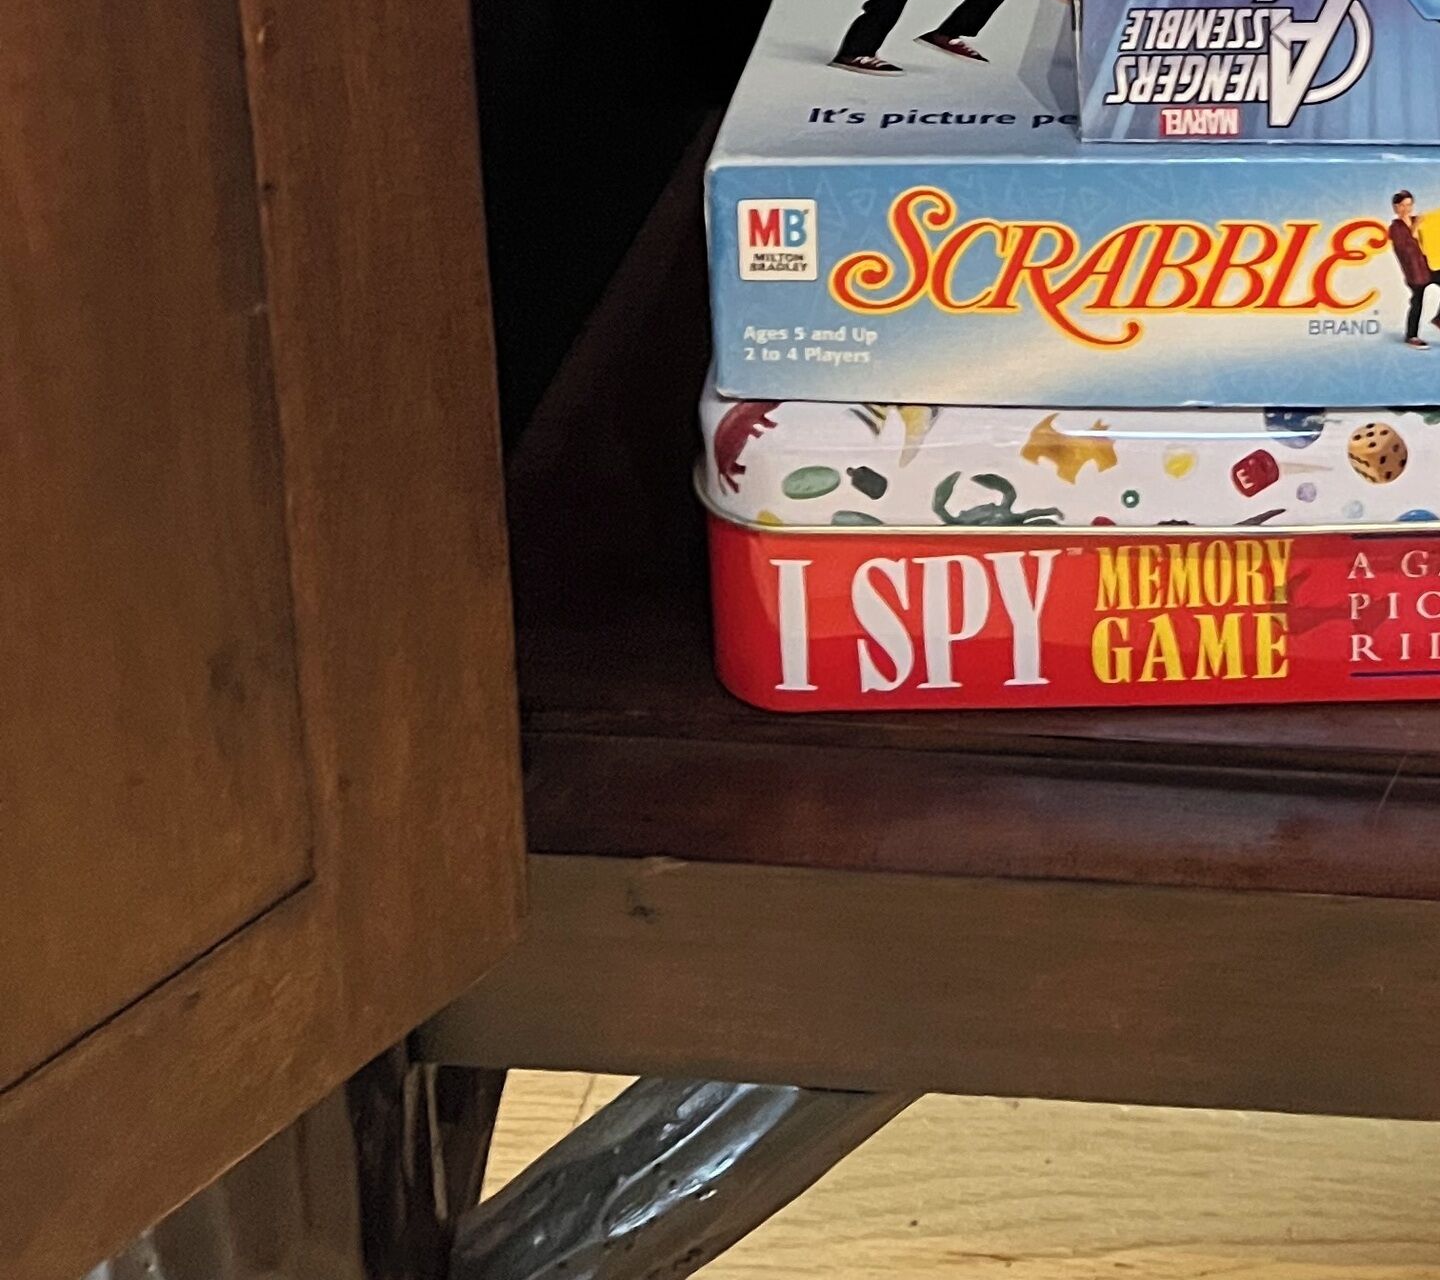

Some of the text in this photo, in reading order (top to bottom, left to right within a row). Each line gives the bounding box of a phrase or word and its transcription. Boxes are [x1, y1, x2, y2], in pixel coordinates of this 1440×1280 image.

[879, 110, 1017, 129] picture
[1161, 107, 1240, 136] MARVEL
[748, 208, 808, 248] MB
[749, 262, 809, 272] BRADLEY
[753, 252, 805, 263] MILTON
[828, 185, 1392, 350] SCRABBLE
[743, 326, 879, 346] Ages 5 and Up
[1308, 318, 1381, 337] BRAND
[744, 347, 871, 367] 2 to 4 Players
[1093, 538, 1296, 612] MEMORY
[1346, 552, 1376, 580] A
[769, 548, 1063, 694] I SPY
[1091, 611, 1290, 685] GAME
